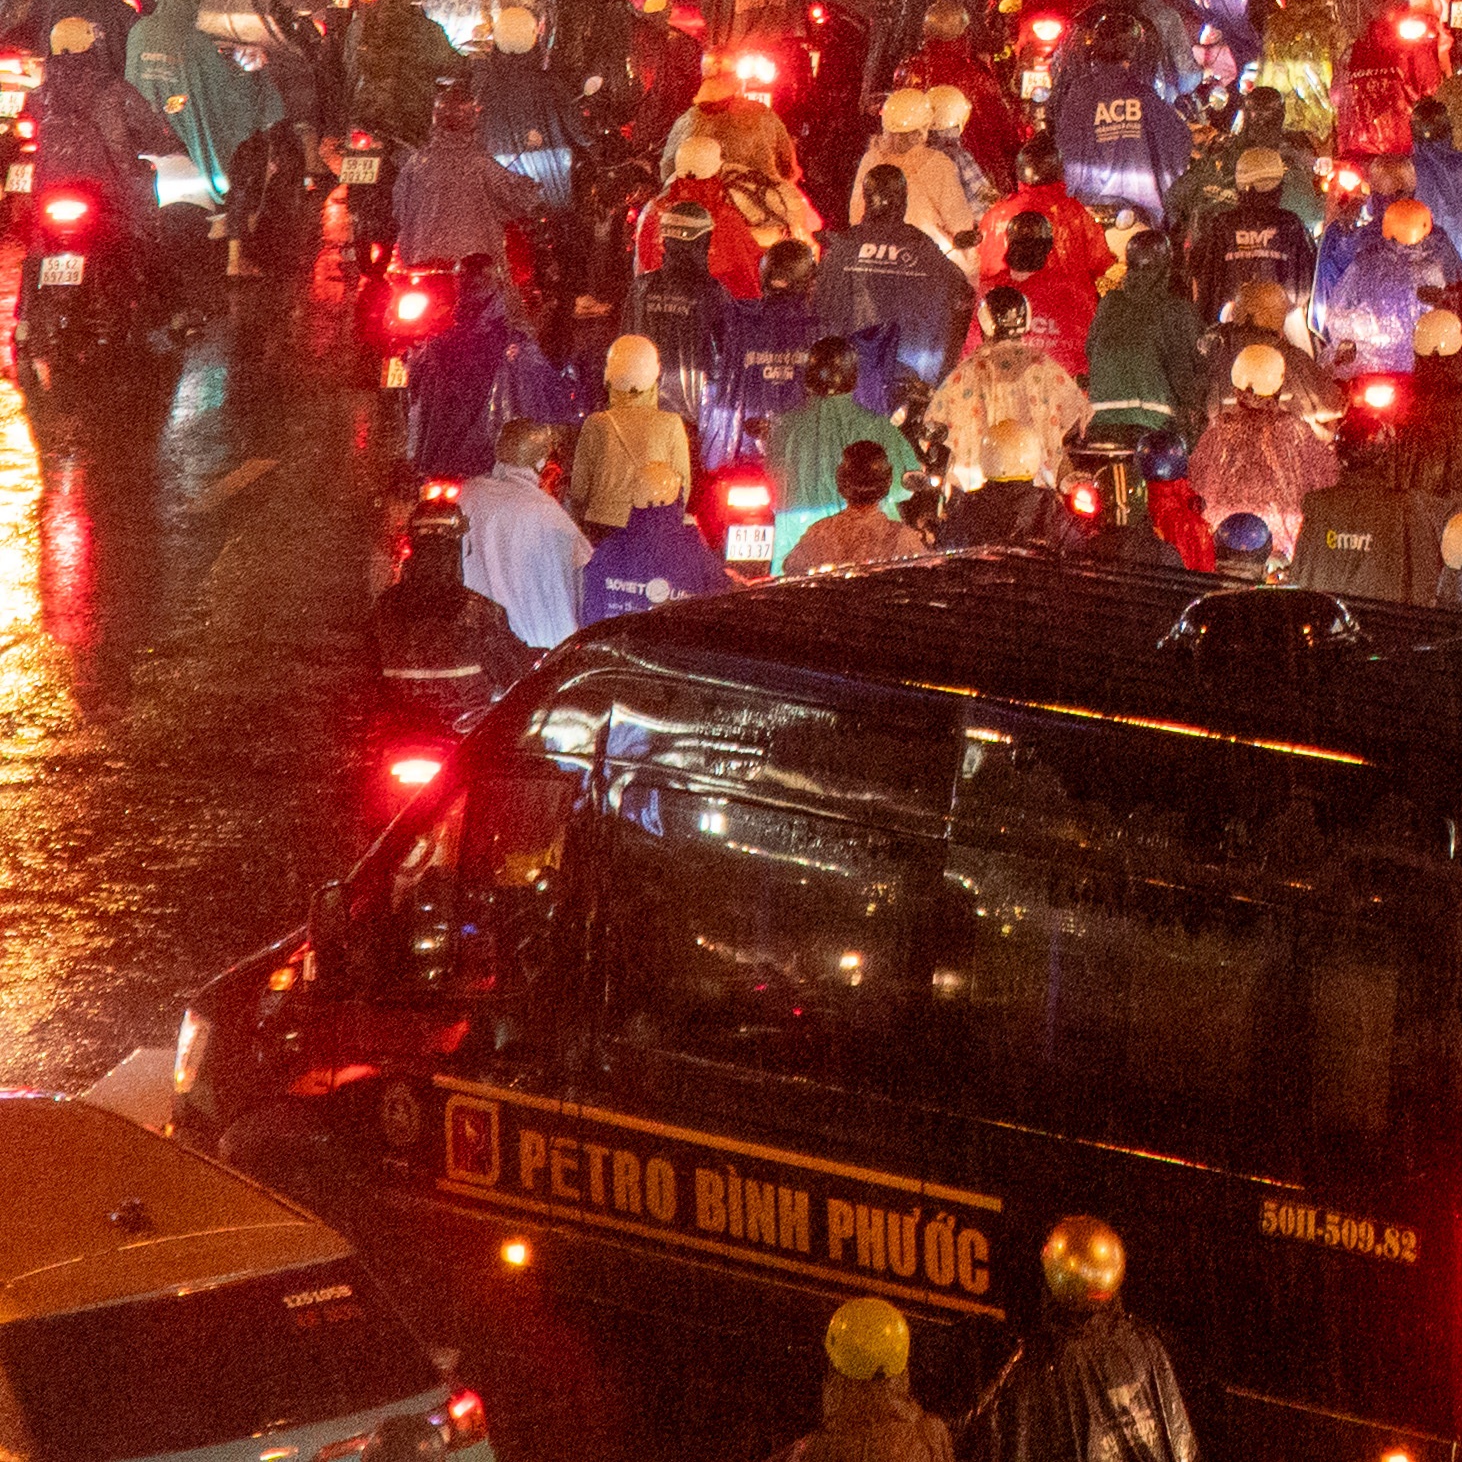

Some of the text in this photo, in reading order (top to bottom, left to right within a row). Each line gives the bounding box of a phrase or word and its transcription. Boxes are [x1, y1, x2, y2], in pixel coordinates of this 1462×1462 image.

[1094, 98, 1142, 126] ACB
[1326, 529, 1373, 551] emart
[517, 1128, 991, 1296] PETRO BÌNH PHƯỚC
[1261, 1201, 1418, 1263] 50H-509.82
